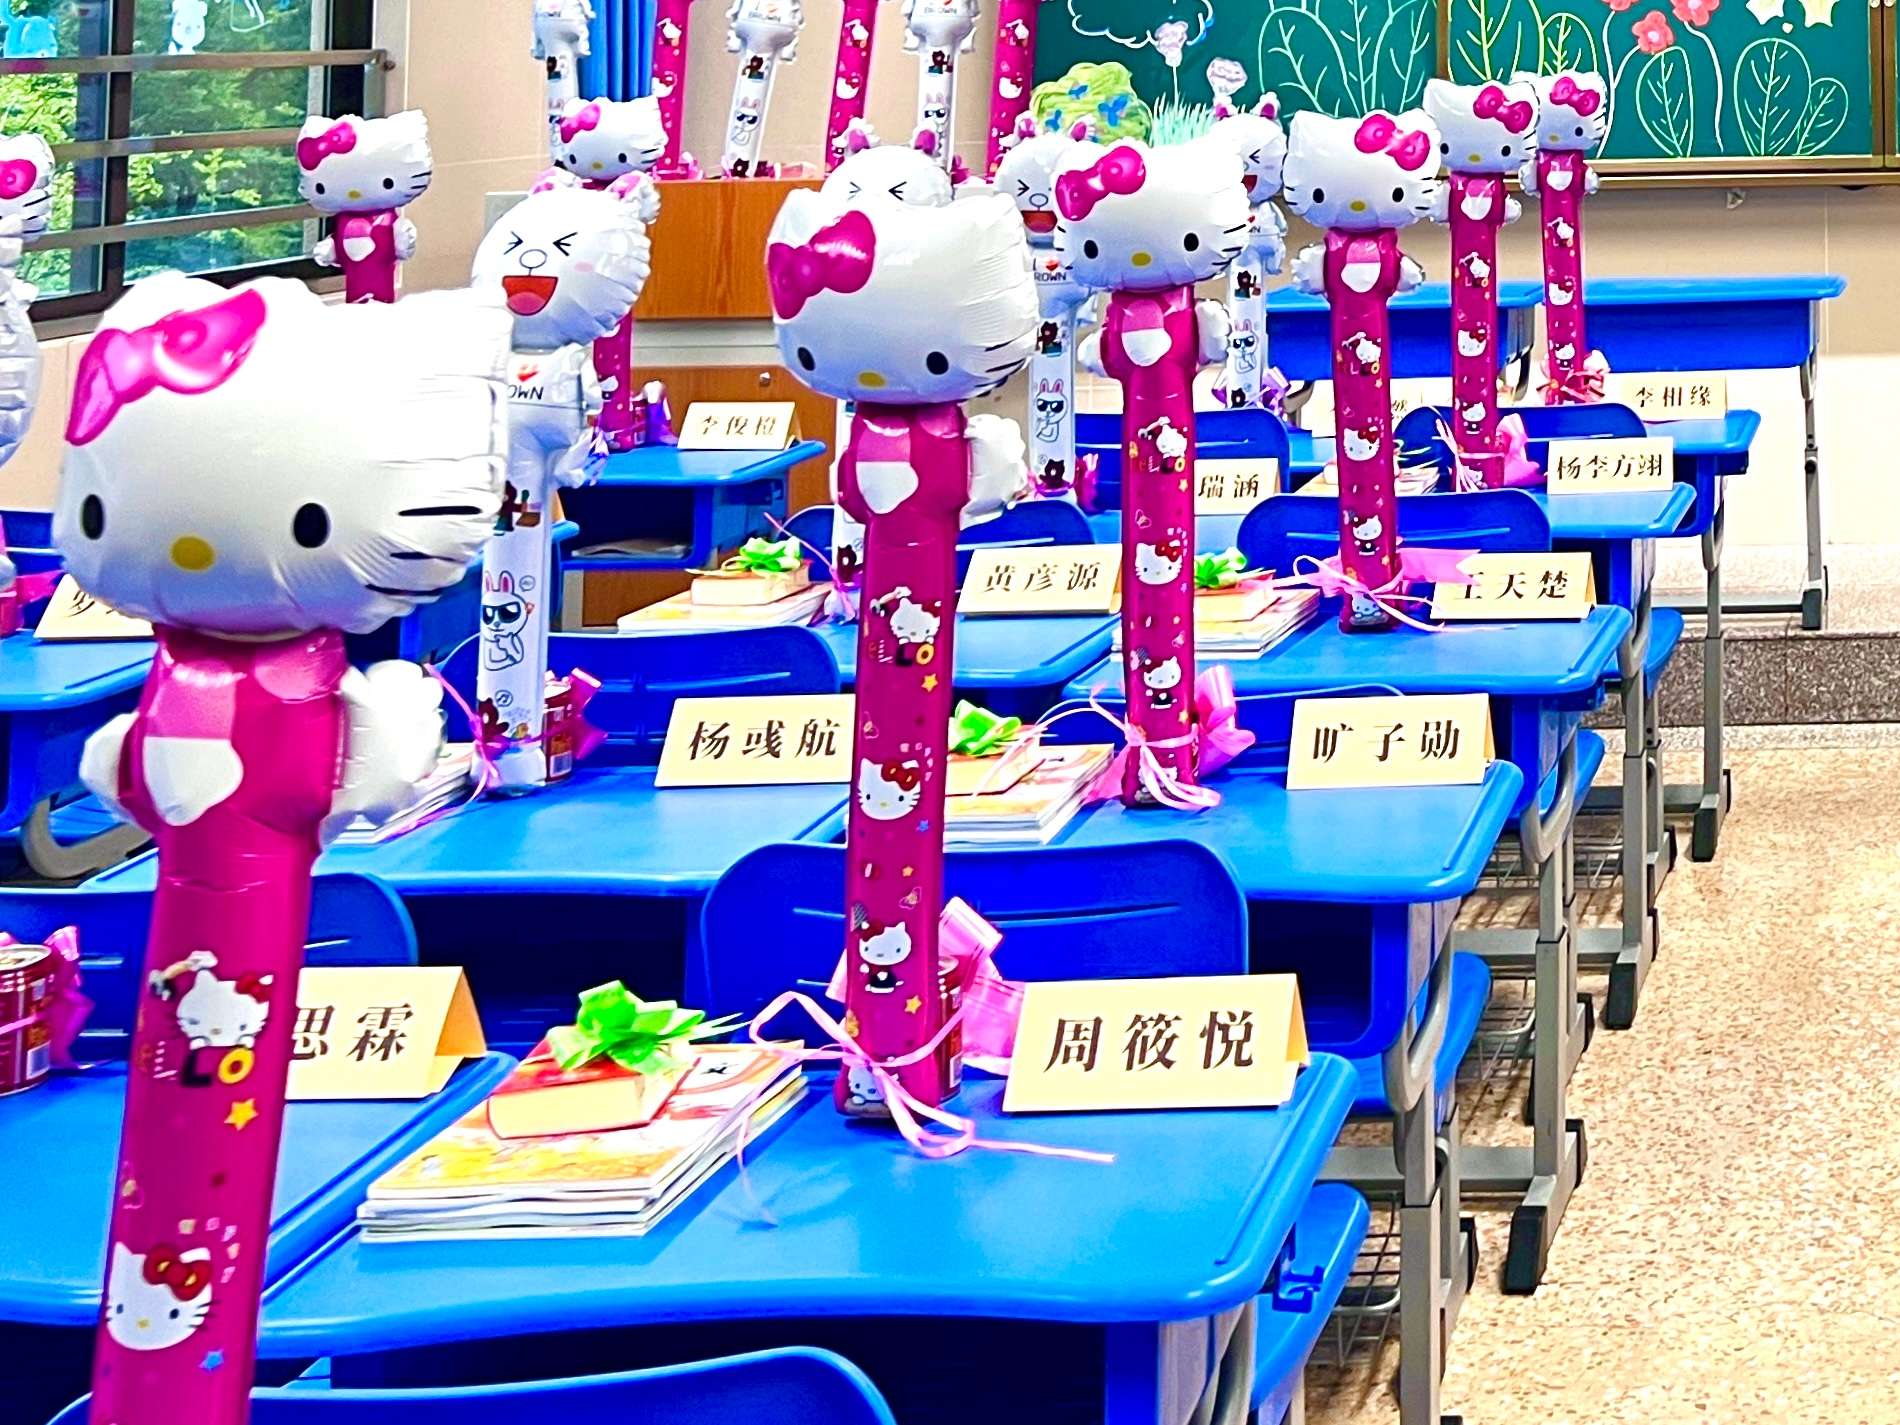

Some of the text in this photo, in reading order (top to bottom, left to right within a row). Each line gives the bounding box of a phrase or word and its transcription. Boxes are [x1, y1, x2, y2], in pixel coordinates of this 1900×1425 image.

[1034, 272, 1066, 281] ROWN
[984, 562, 1100, 592] 黄彦源
[1313, 720, 1460, 763] 旷子勋
[1045, 1010, 1255, 1072] 周筱悦
